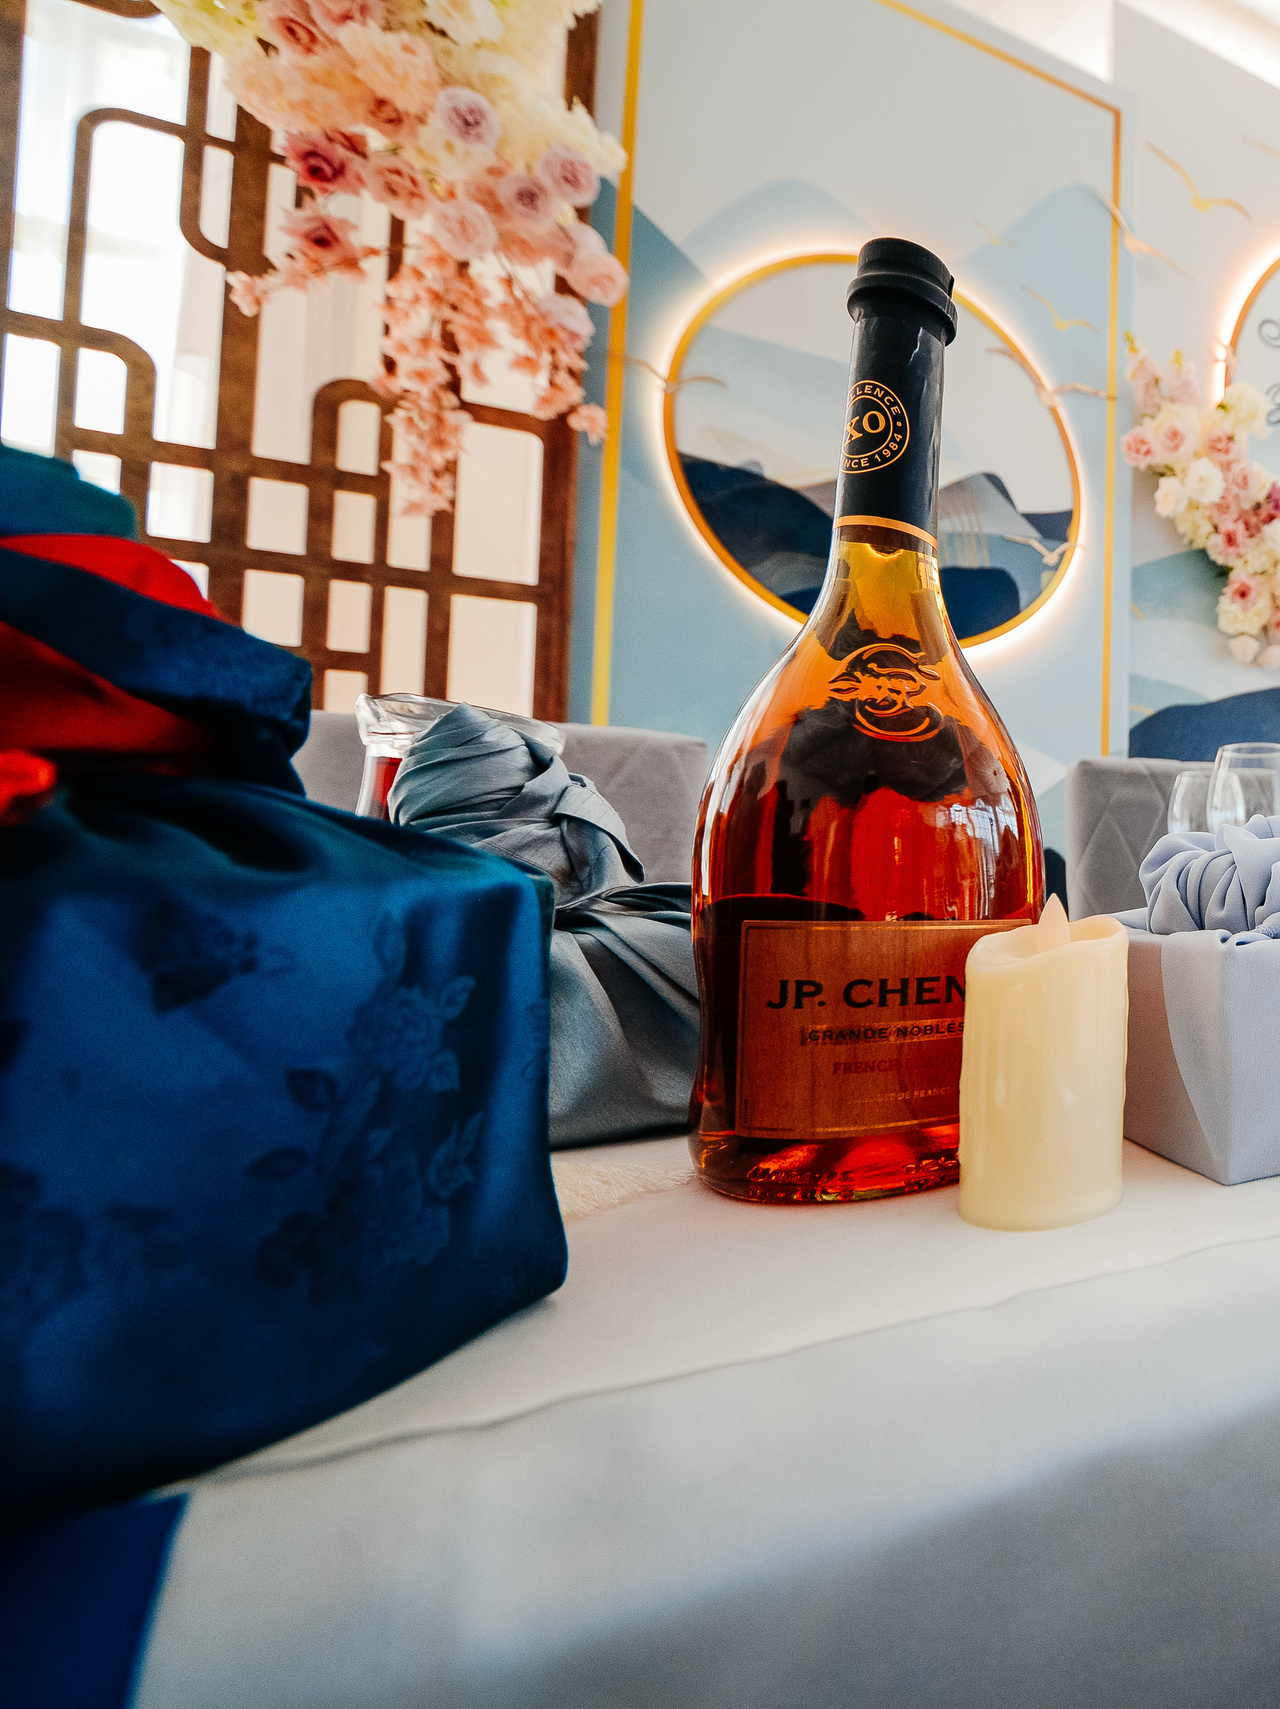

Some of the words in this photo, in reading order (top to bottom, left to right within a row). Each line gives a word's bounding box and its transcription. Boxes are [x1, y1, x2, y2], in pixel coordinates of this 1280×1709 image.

[844, 410, 886, 447] XO
[874, 433, 903, 462] 1984
[766, 978, 826, 1010] JP.
[808, 1026, 890, 1043] GRANDE
[832, 1058, 899, 1075] FRENCH
